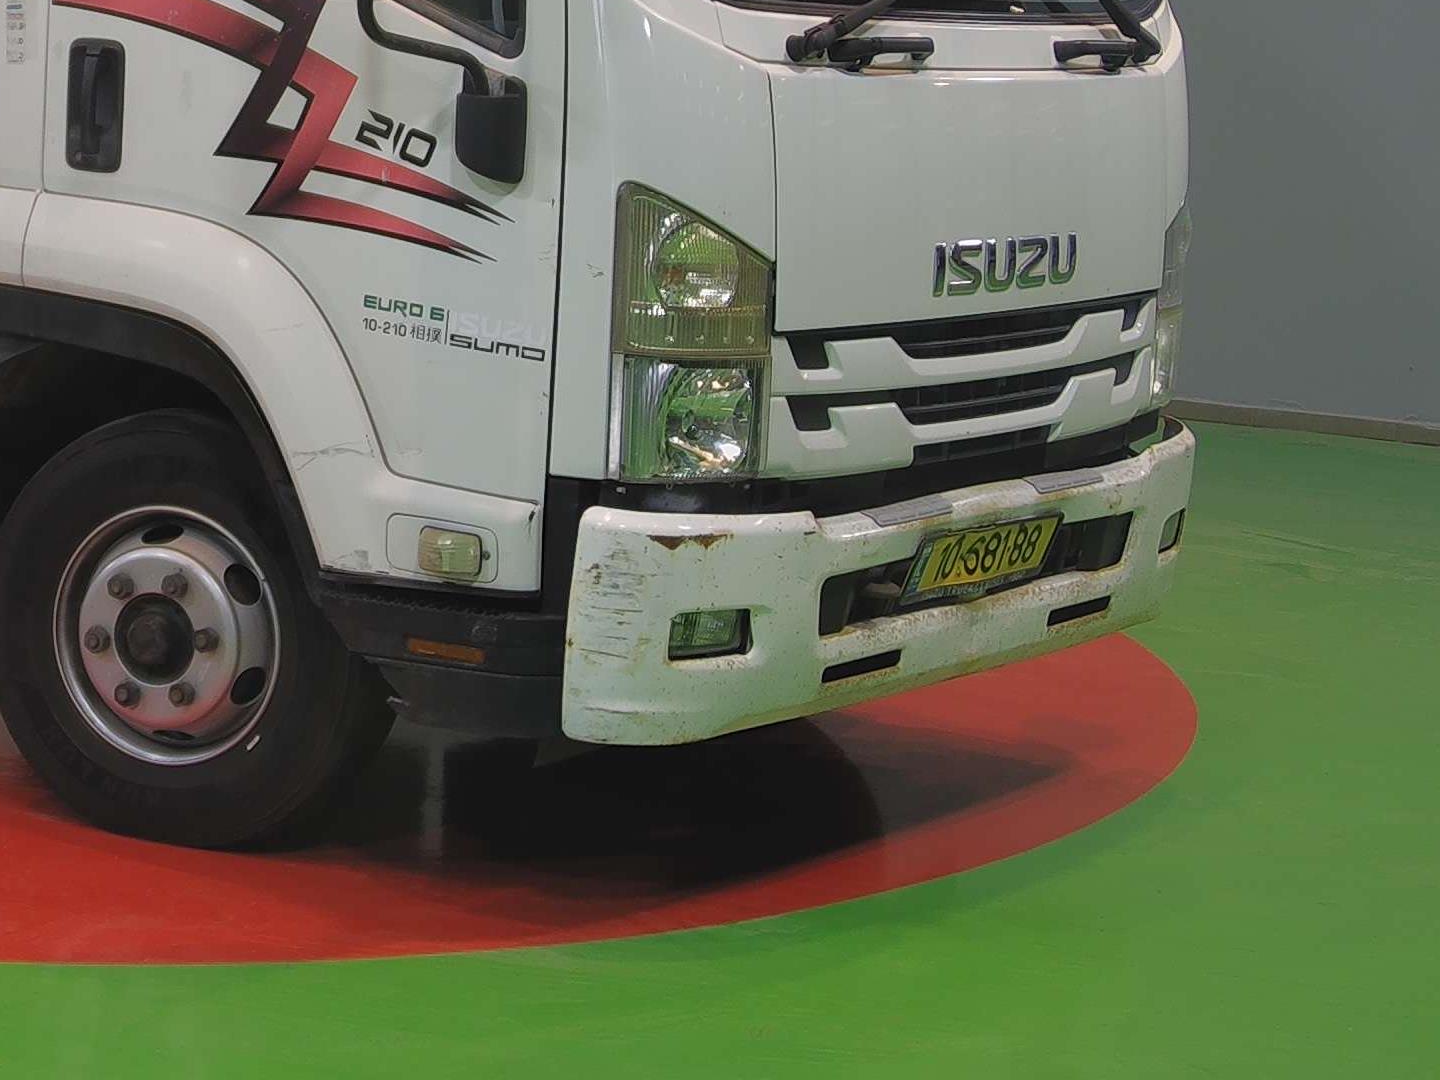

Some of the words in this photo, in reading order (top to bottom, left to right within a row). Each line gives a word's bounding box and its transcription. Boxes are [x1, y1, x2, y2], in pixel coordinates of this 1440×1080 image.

[355, 108, 437, 168] 210
[932, 231, 1077, 297] ISUZU
[363, 294, 424, 317] EURO
[429, 307, 445, 321] 6
[362, 318, 408, 337] 10-210
[449, 333, 546, 362] SUMO
